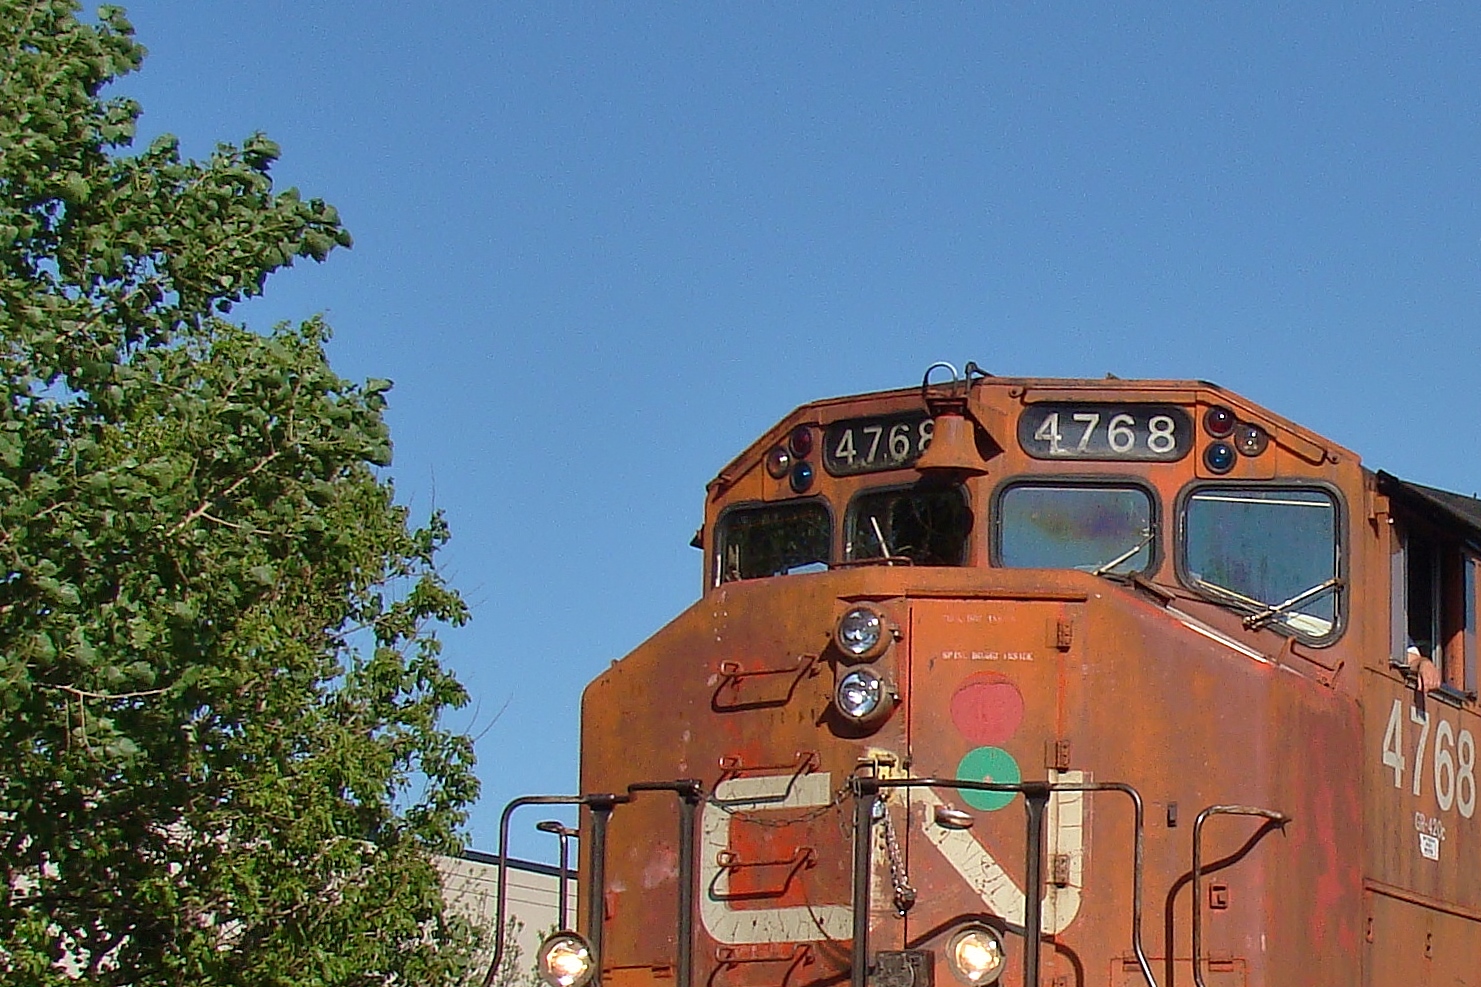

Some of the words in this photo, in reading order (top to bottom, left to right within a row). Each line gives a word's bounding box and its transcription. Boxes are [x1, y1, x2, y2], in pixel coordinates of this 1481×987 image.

[833, 418, 936, 465] 4768
[1033, 412, 1177, 454] 4768
[1382, 699, 1477, 819] 4768
[700, 770, 1084, 945] CN
